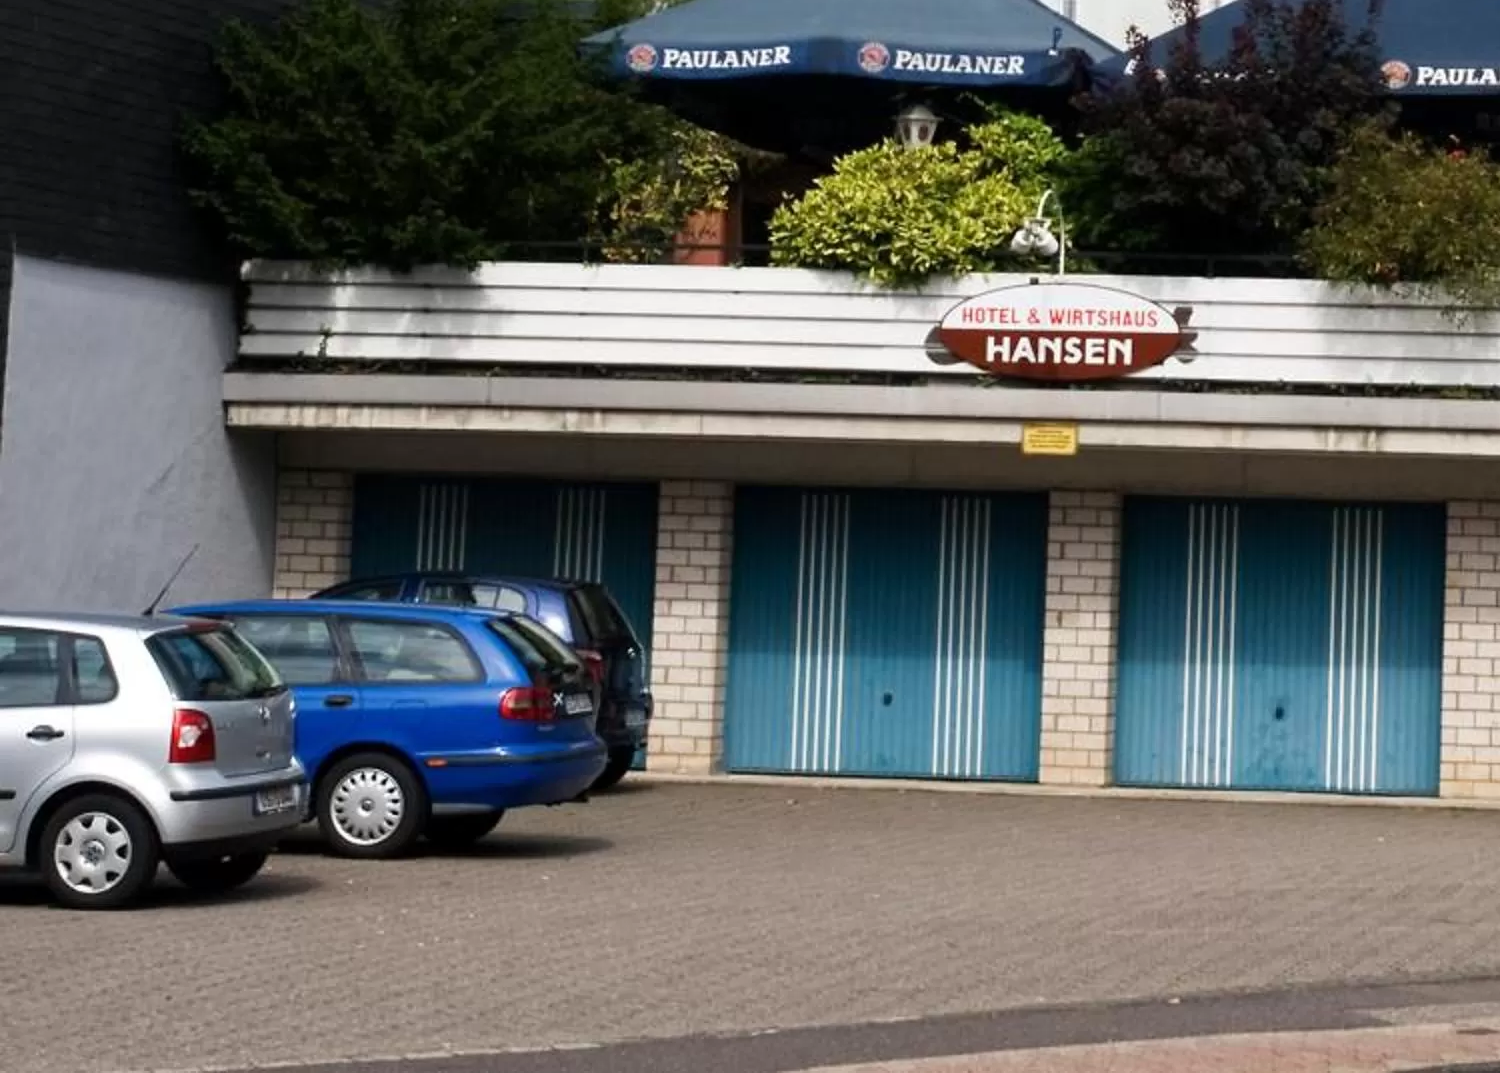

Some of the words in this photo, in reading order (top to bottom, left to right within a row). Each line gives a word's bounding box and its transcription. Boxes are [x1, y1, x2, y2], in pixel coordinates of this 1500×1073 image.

[663, 46, 790, 68] PAULANER
[894, 50, 1025, 74] PAULANER
[962, 307, 1020, 324] HOTEL
[1027, 308, 1041, 324] &
[1049, 308, 1158, 327] WIRTSHAUS
[985, 336, 1133, 365] HANSEN
